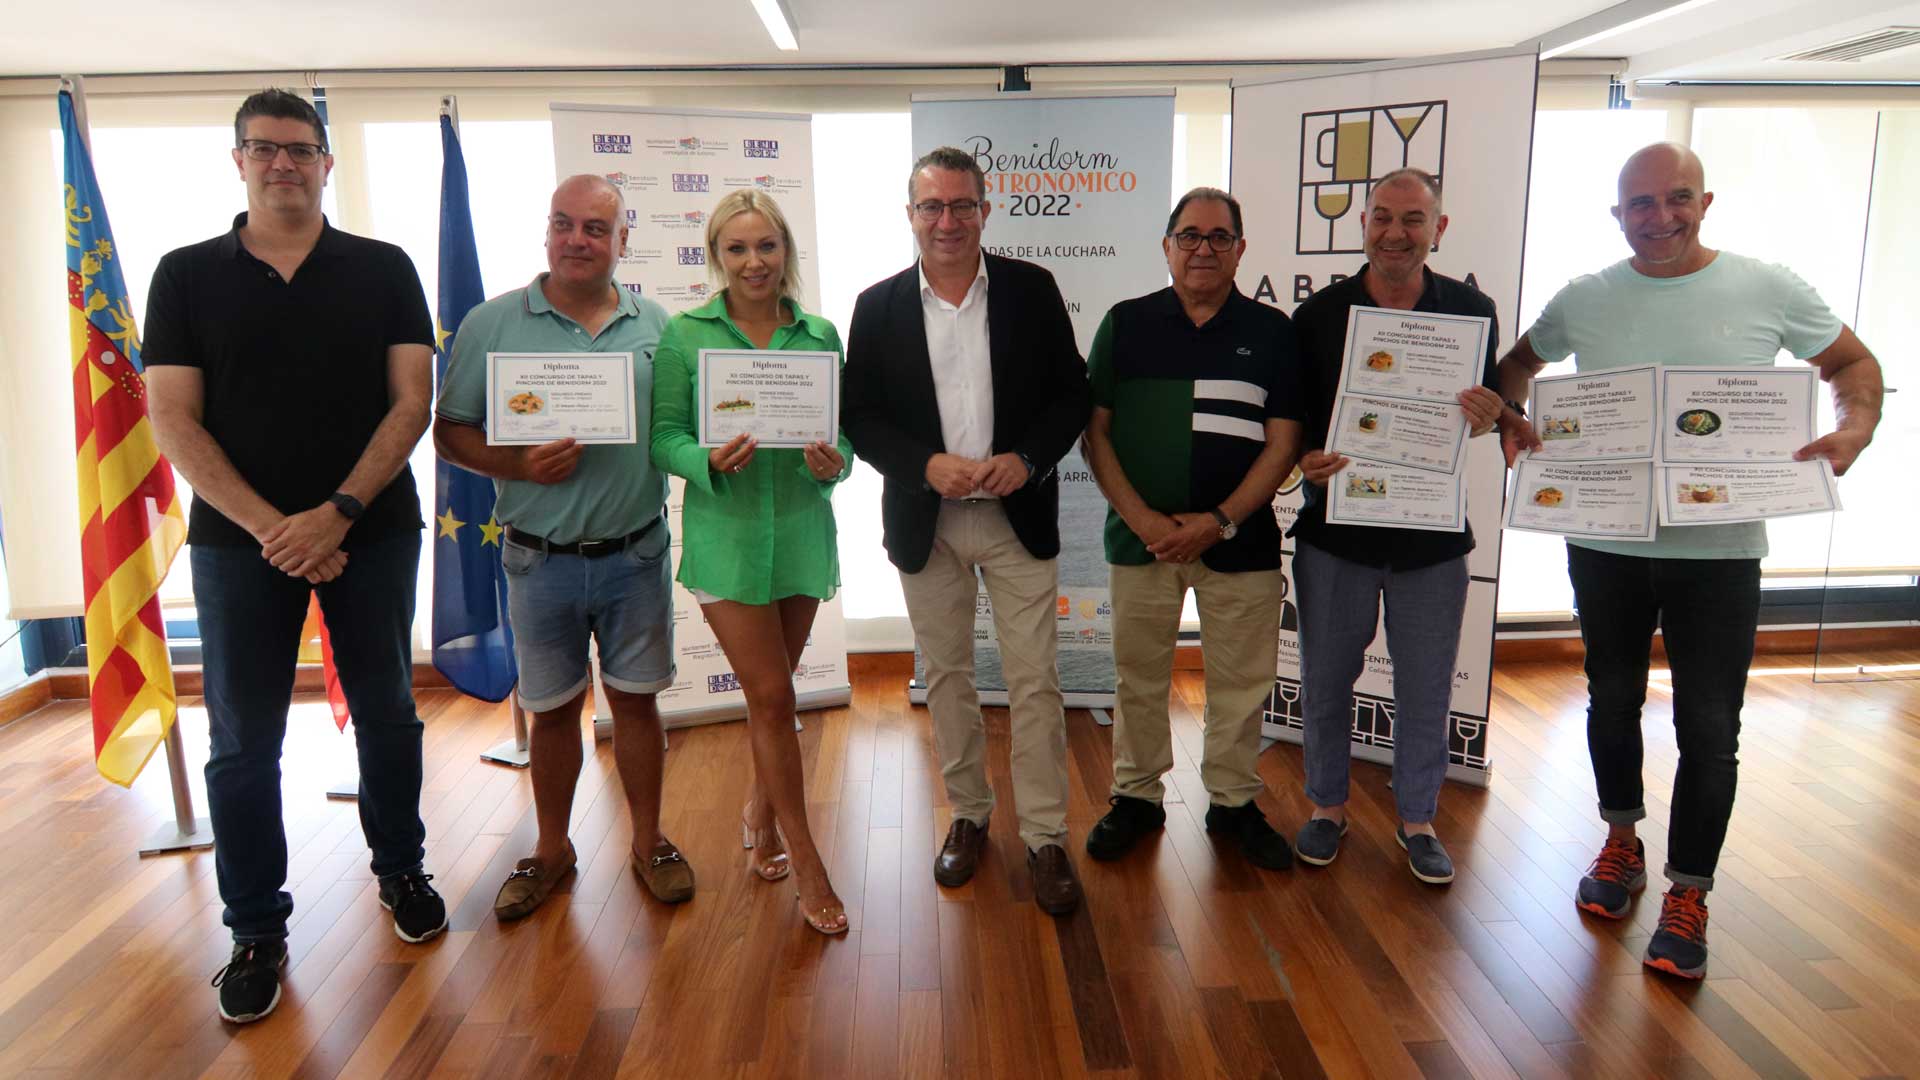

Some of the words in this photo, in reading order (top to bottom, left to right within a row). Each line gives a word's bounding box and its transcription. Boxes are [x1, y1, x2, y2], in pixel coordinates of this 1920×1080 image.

[593, 134, 631, 144] BENI
[594, 144, 632, 153] DORM
[743, 140, 778, 149] BENI
[744, 149, 779, 158] DORM
[964, 135, 1119, 174] Benidorm
[672, 174, 708, 183] BENI
[674, 183, 709, 192] DORM
[1009, 194, 1071, 217] 2022
[678, 247, 705, 256] BEN
[1017, 246, 1033, 258] DE
[1037, 246, 1052, 258] LA
[1055, 245, 1117, 258] CUCHARA
[679, 256, 706, 265] DOR
[1401, 321, 1435, 332] Diploma
[543, 362, 580, 372] Diploma
[752, 361, 788, 370] Diploma
[1577, 381, 1611, 392] Diploma
[1717, 378, 1758, 388] Diploma
[1279, 638, 1300, 650] TELE
[1363, 654, 1393, 666] CENTR
[708, 673, 736, 684] BEN
